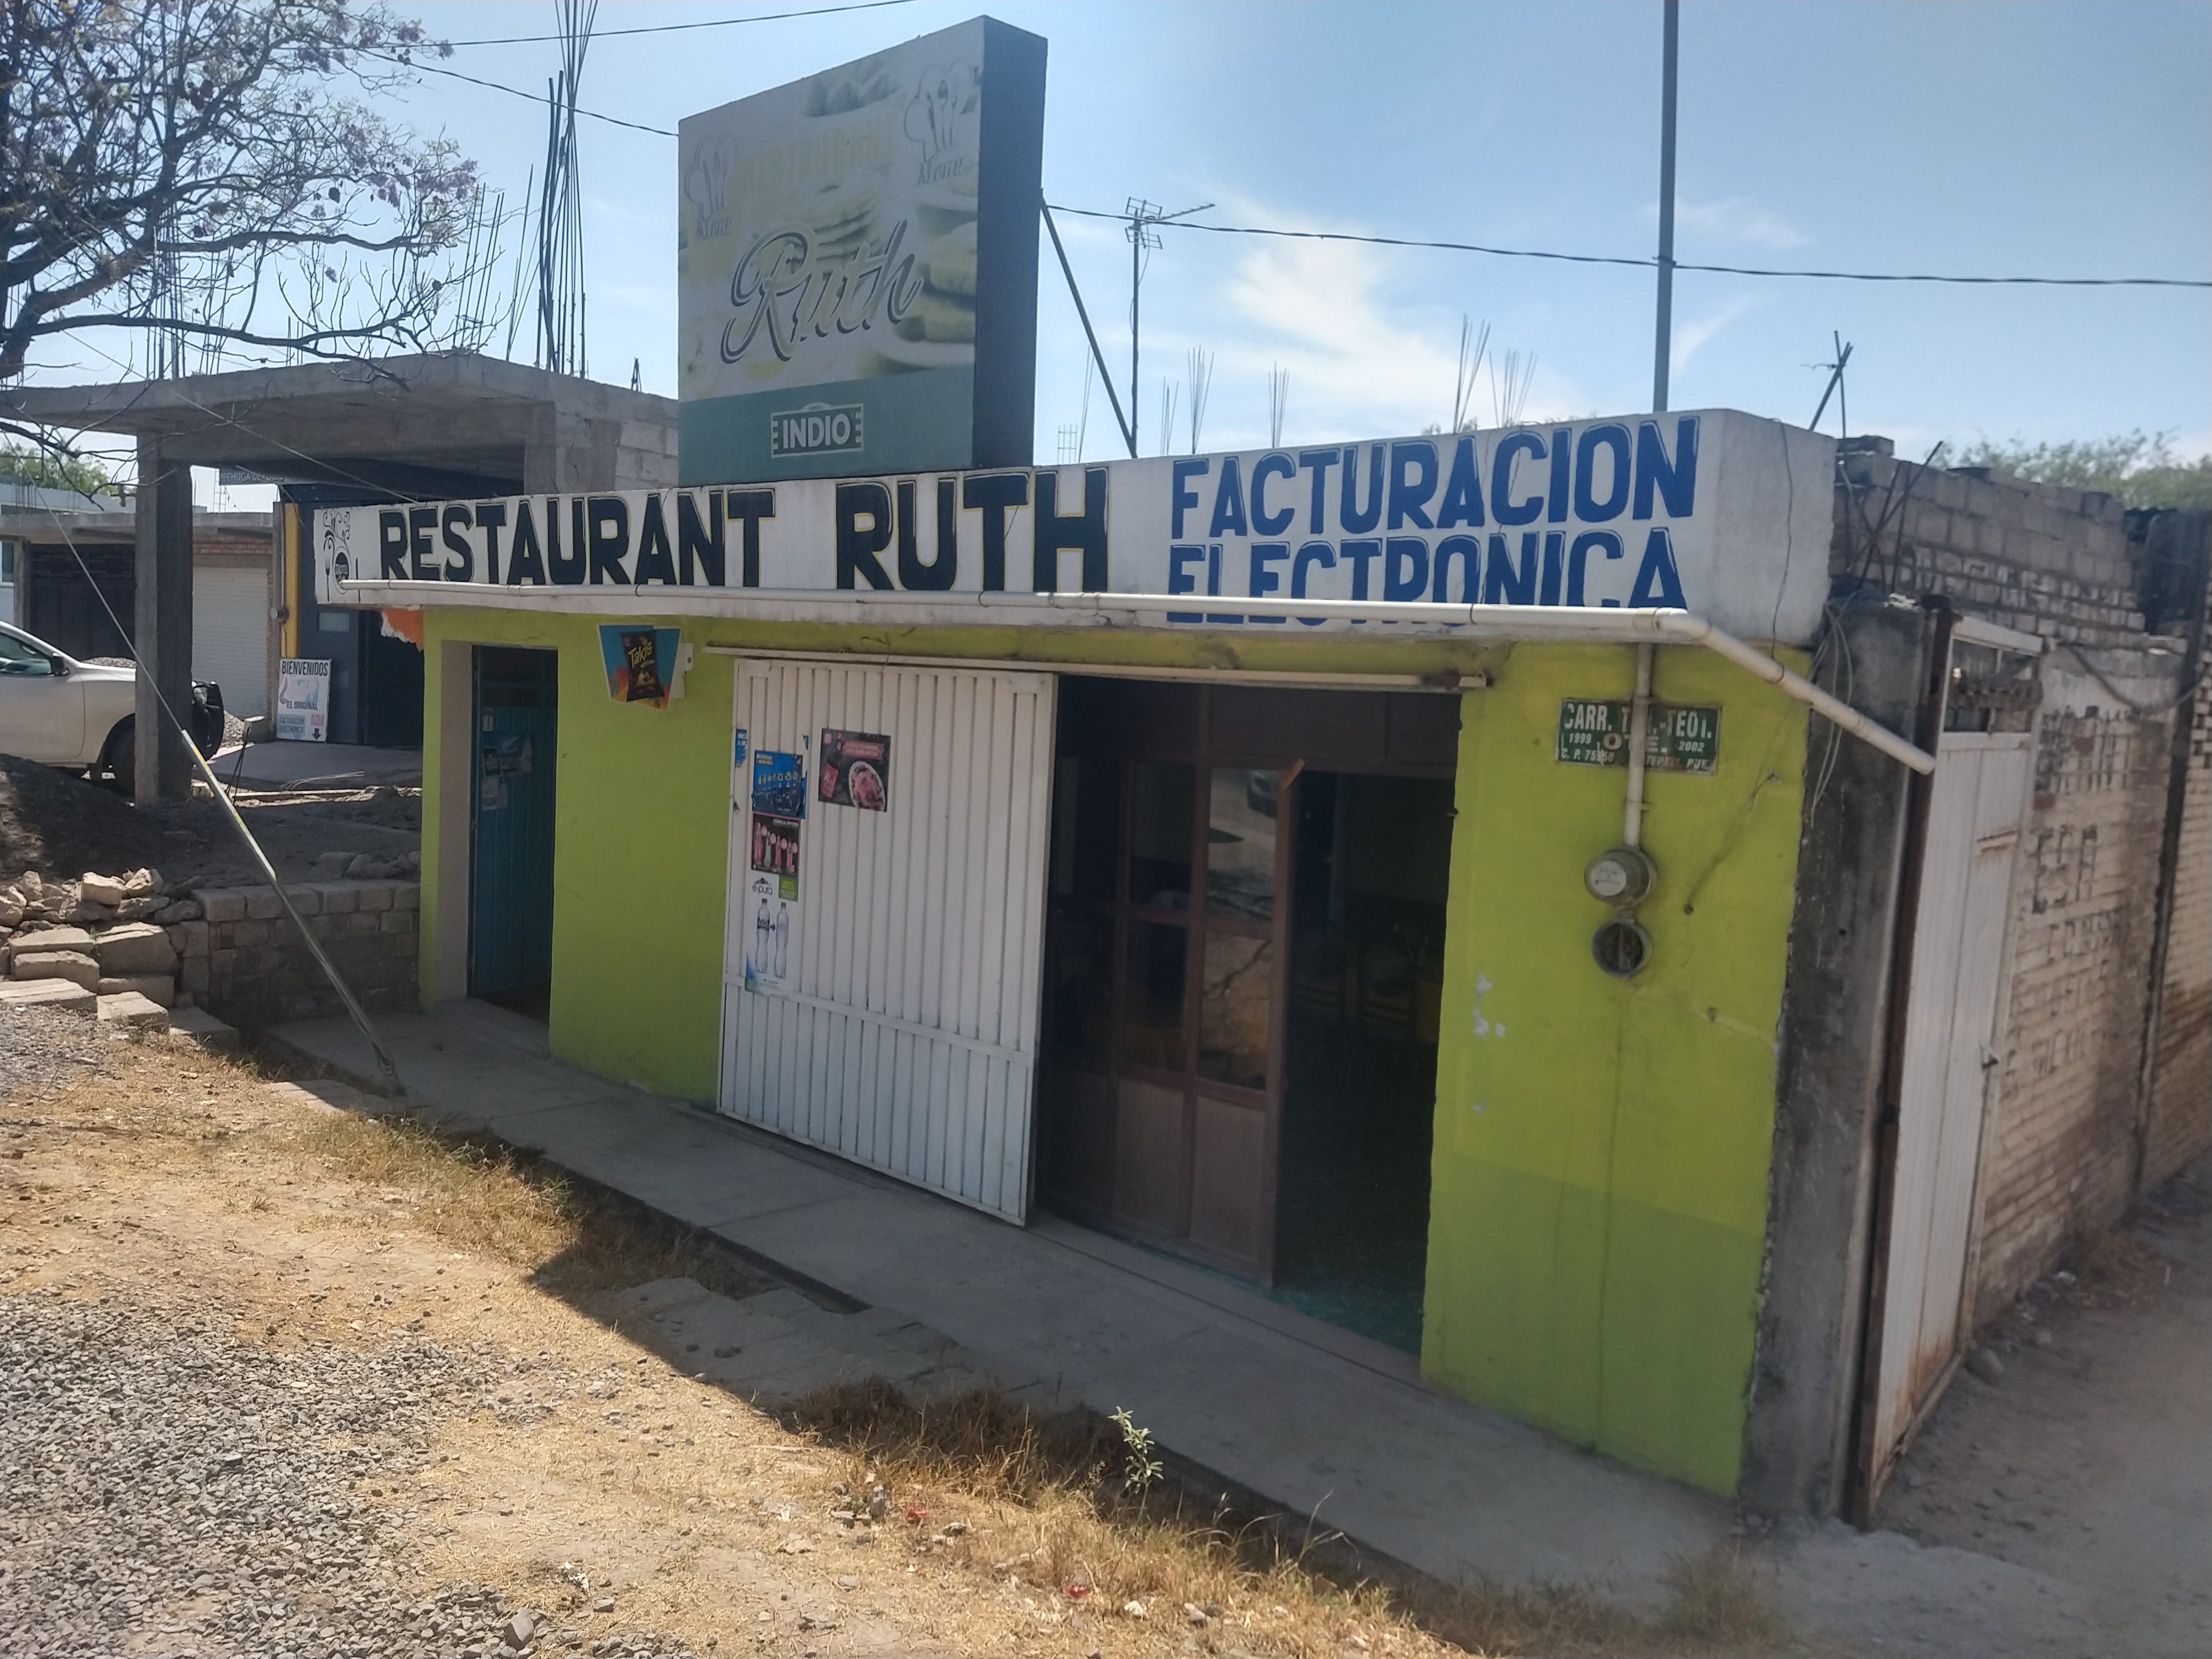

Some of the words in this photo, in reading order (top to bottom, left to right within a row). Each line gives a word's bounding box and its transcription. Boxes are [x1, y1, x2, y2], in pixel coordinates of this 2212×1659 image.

[720, 220, 924, 364] Ruth
[783, 413, 850, 449] INDIO
[1172, 416, 1700, 539] FACTURACION
[379, 488, 775, 588] RESTAURANT
[836, 466, 1109, 593] RUTH
[1166, 526, 1689, 627] ELECTRONICA
[281, 661, 329, 676] BIENVENIDOS
[628, 641, 652, 669] Takis
[286, 701, 292, 709] EL
[294, 701, 319, 710] ORIGINAL
[1564, 703, 1612, 731] CARR.
[1569, 732, 1592, 744] 1999
[1678, 740, 1705, 753] 2002
